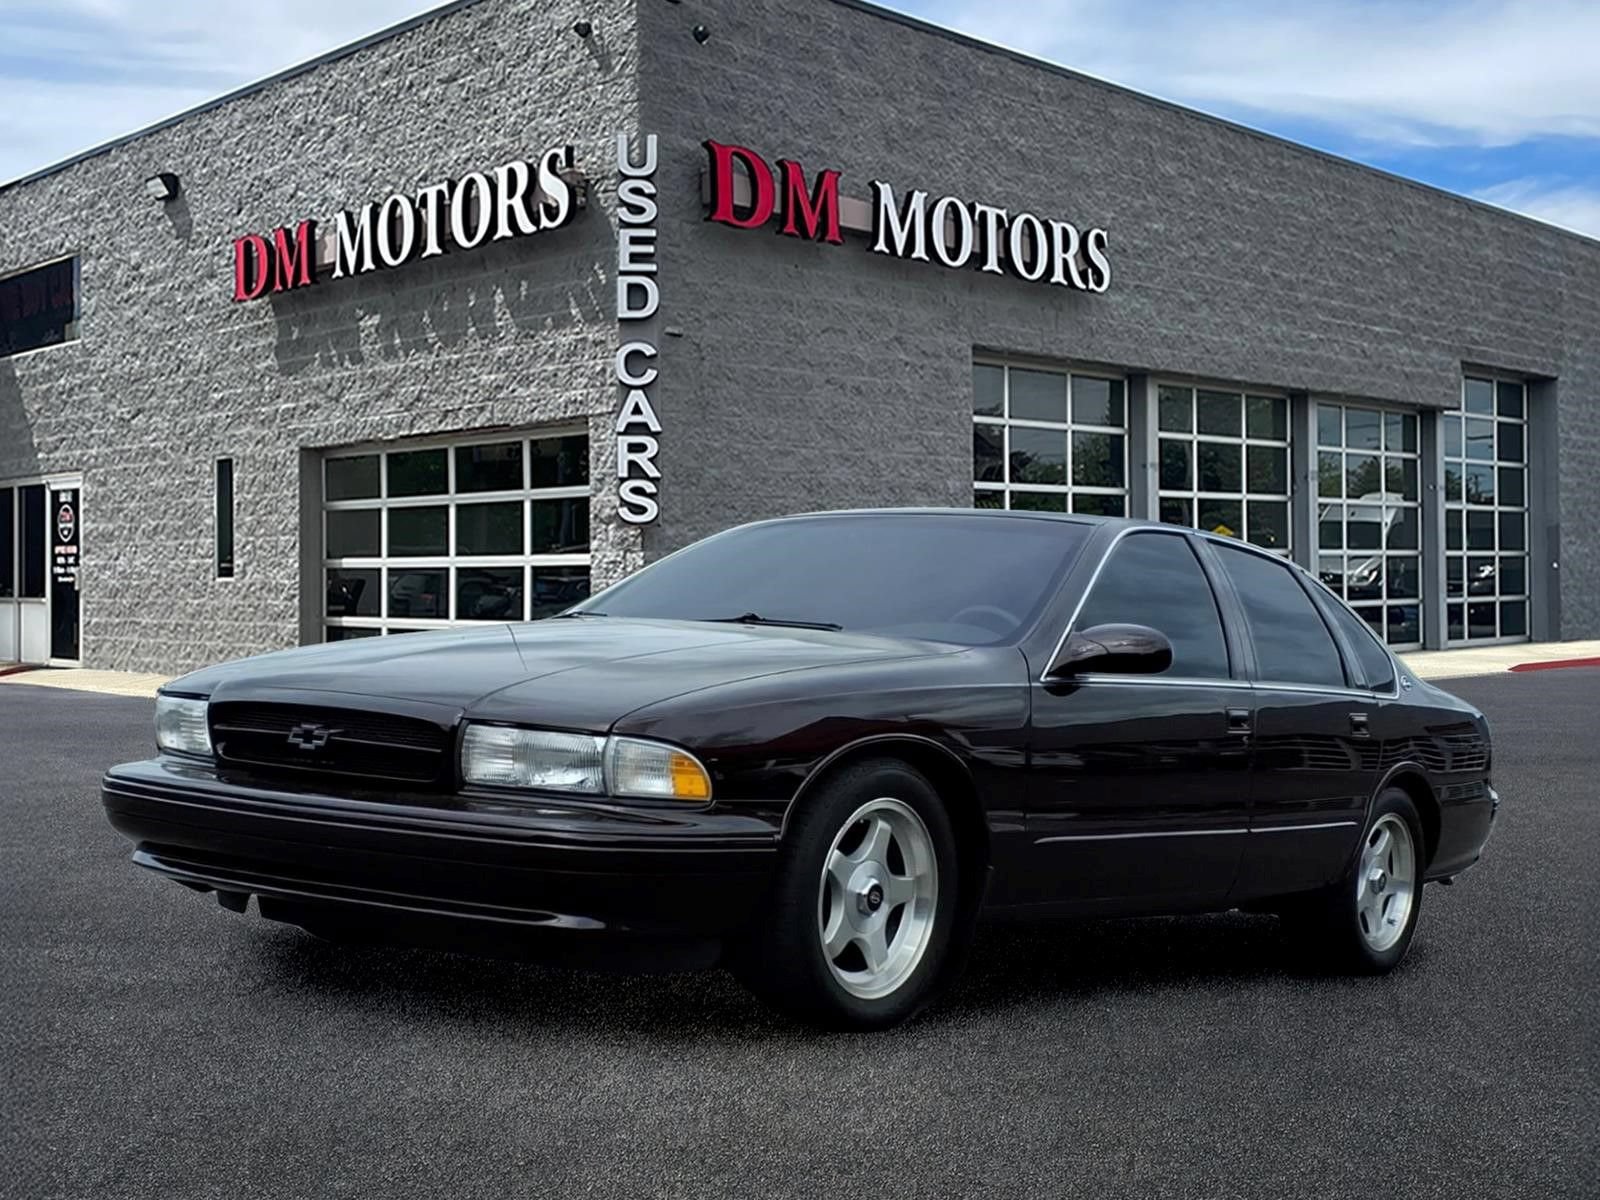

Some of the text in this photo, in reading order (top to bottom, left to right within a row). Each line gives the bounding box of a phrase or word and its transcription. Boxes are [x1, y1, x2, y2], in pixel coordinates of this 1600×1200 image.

[232, 146, 575, 301] DM MOTORS
[704, 140, 1111, 293] DM MOTORS
[614, 133, 662, 524] USED CARS
